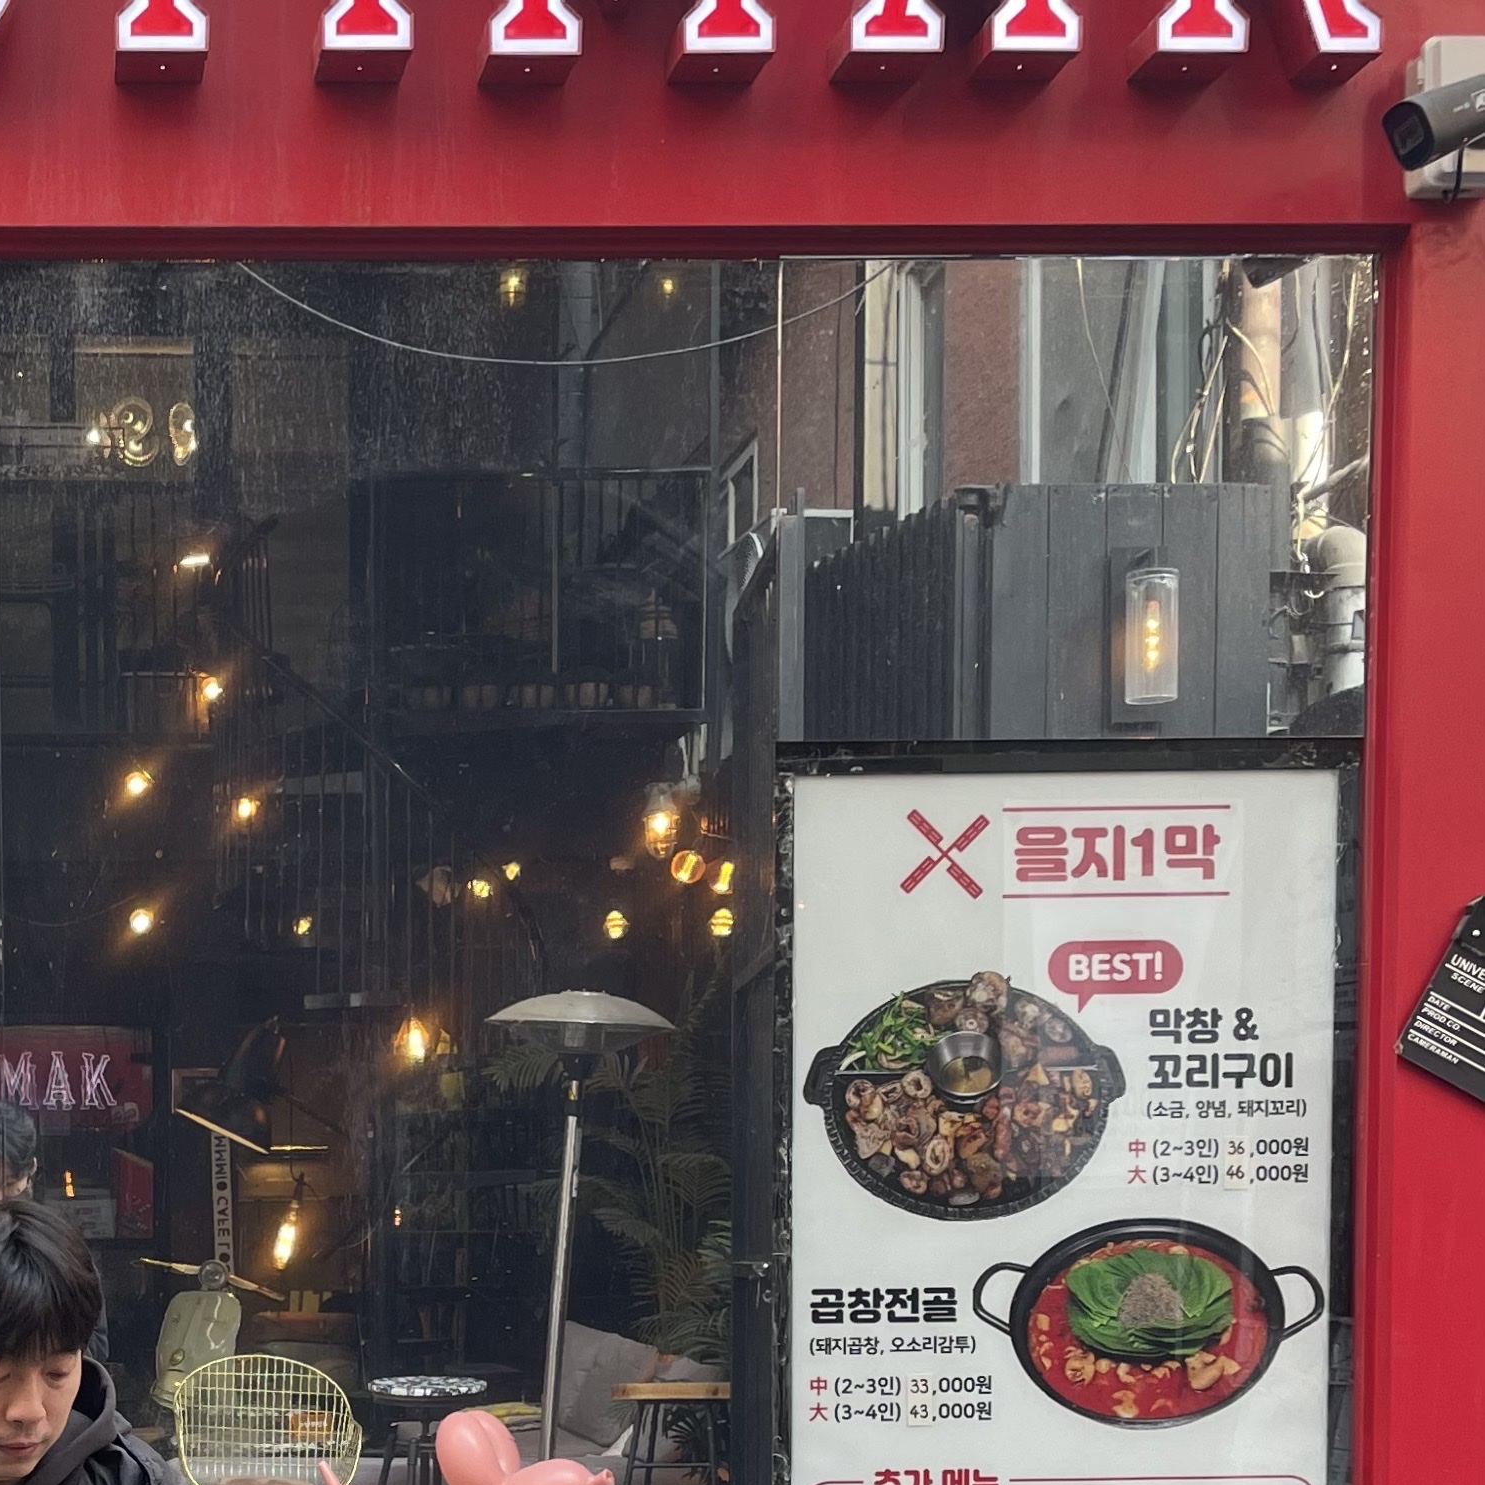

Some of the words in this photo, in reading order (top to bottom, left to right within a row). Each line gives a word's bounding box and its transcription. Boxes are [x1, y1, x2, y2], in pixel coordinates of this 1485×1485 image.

[1015, 825, 1220, 882] 을지1막
[1068, 953, 1164, 981] BEST!
[1451, 972, 1485, 994] SCENE
[1428, 996, 1451, 1011] DATE
[1149, 1008, 1222, 1044] 막창
[1233, 1009, 1259, 1041] &
[1414, 1020, 1457, 1046] DIRECTOR
[1408, 1033, 1459, 1064] CAMERAMAN
[1148, 1052, 1294, 1089] 꼬리구이
[1146, 1101, 1191, 1120] (소금,
[1196, 1100, 1232, 1119] 양념,
[1237, 1099, 1307, 1118] 돼지꼬리)
[1128, 1140, 1146, 1158] 中
[1152, 1139, 1220, 1158] (2~3인)
[1227, 1137, 1309, 1158] 36,000원
[1128, 1166, 1147, 1185] 大
[1152, 1165, 1220, 1186] (3~4인)
[1226, 1164, 1309, 1184] 46,000원
[810, 1287, 958, 1323] 곱창전골
[810, 1336, 884, 1357] (돼지곱창,
[889, 1335, 976, 1356] 오소리감투)
[810, 1377, 828, 1397] 中
[834, 1376, 901, 1397] (2~3인)
[910, 1375, 992, 1396] 33,000원
[810, 1403, 828, 1422] 大
[834, 1401, 901, 1423] (3~4인)
[909, 1402, 992, 1422] 43,000원
